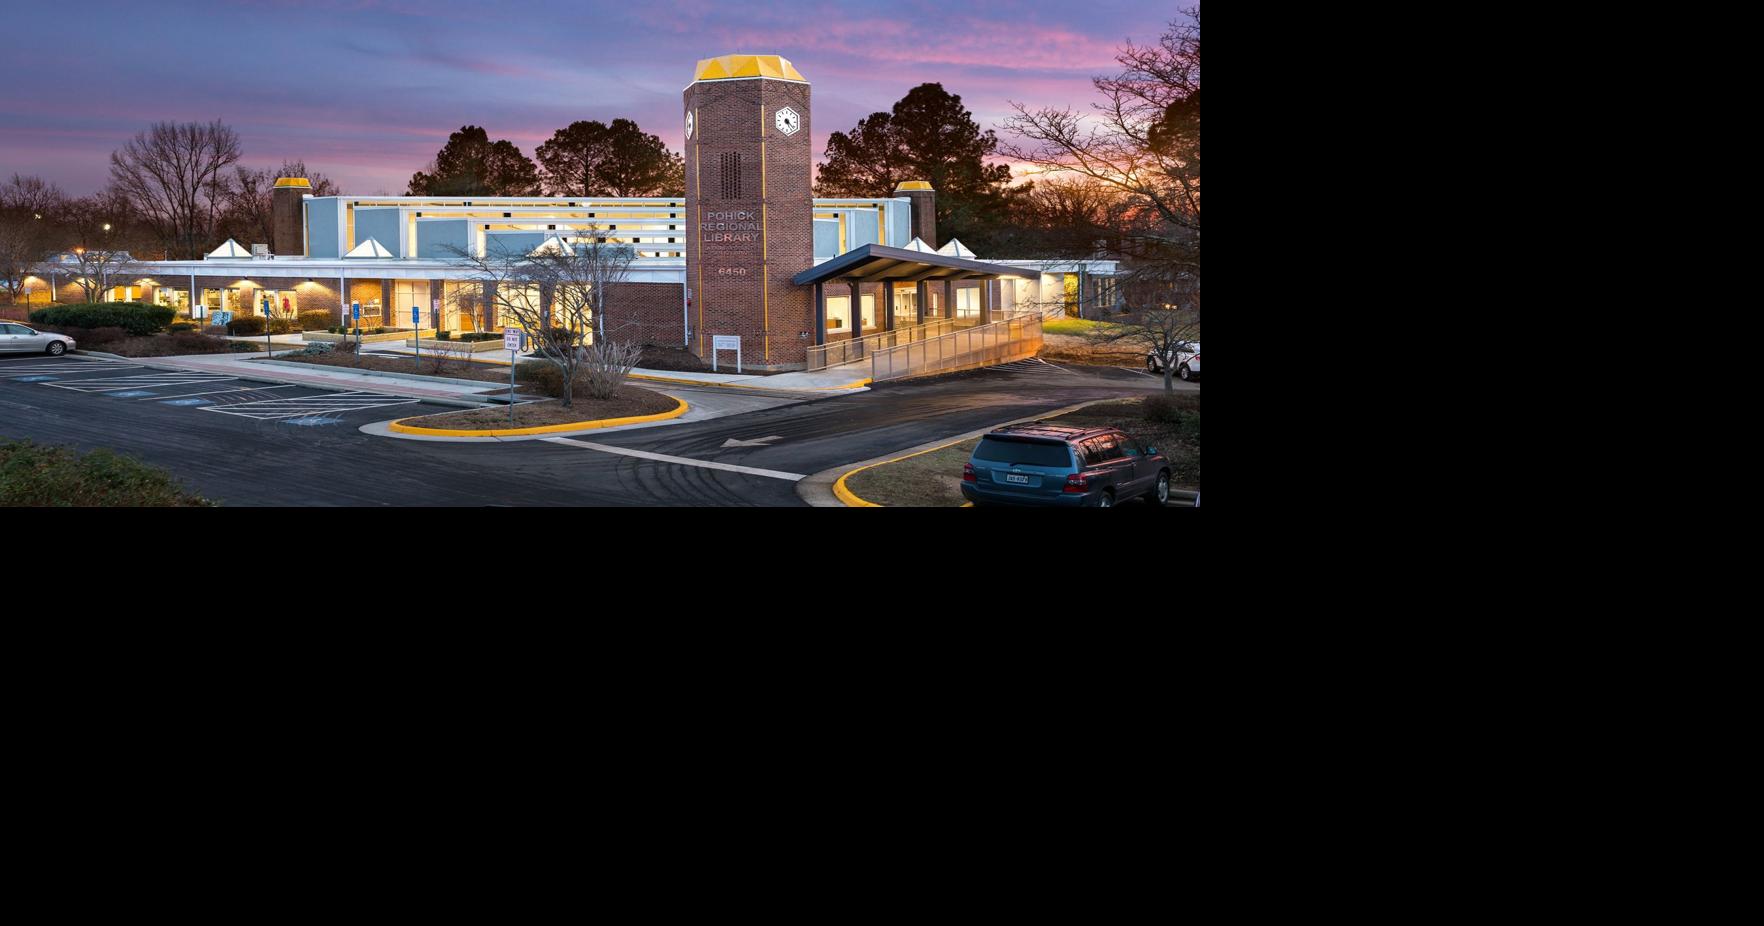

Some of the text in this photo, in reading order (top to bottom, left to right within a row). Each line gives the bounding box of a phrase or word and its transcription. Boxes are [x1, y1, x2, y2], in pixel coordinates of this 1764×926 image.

[707, 211, 754, 220] POHICK
[701, 223, 764, 231] REGIONAL
[704, 233, 760, 242] LIBRARY
[718, 267, 746, 276] 6450
